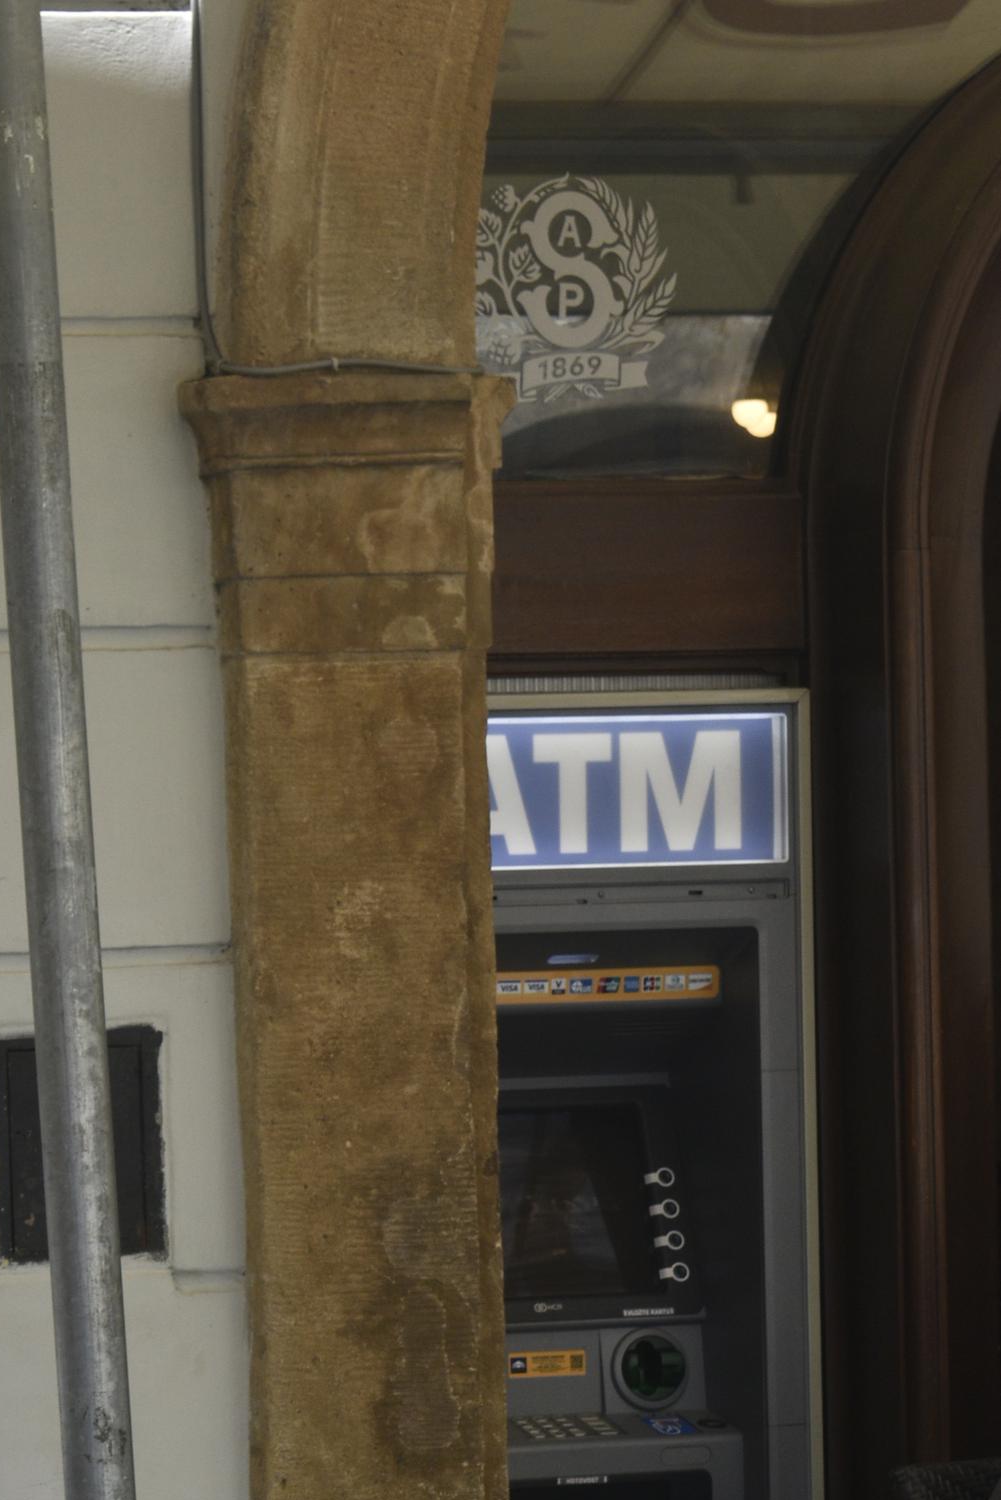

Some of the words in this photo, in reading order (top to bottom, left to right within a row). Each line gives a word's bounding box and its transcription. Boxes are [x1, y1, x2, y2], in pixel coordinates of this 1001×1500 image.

[557, 215, 581, 248] A
[558, 282, 585, 321] P
[537, 355, 602, 381] 1869
[486, 730, 741, 856] ATM
